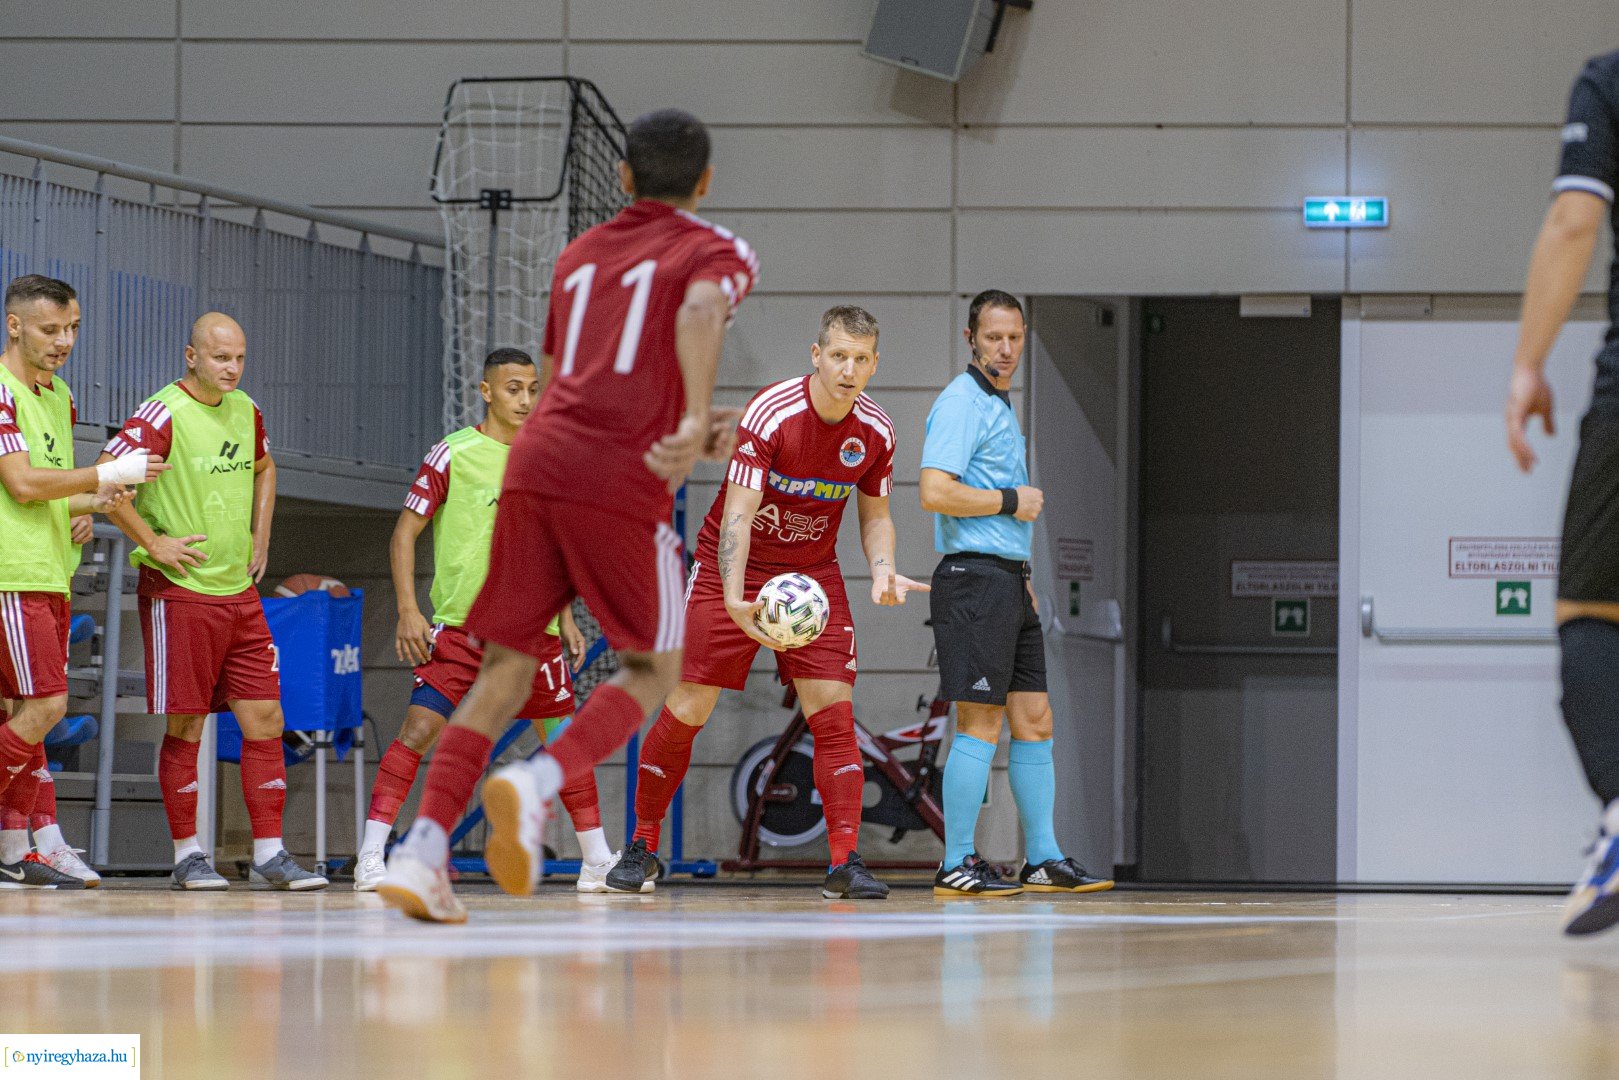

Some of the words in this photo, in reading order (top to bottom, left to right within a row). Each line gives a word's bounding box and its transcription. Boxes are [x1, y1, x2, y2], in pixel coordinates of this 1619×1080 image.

[564, 259, 658, 377] 11
[843, 626, 855, 655] 7
[540, 654, 566, 690] 17
